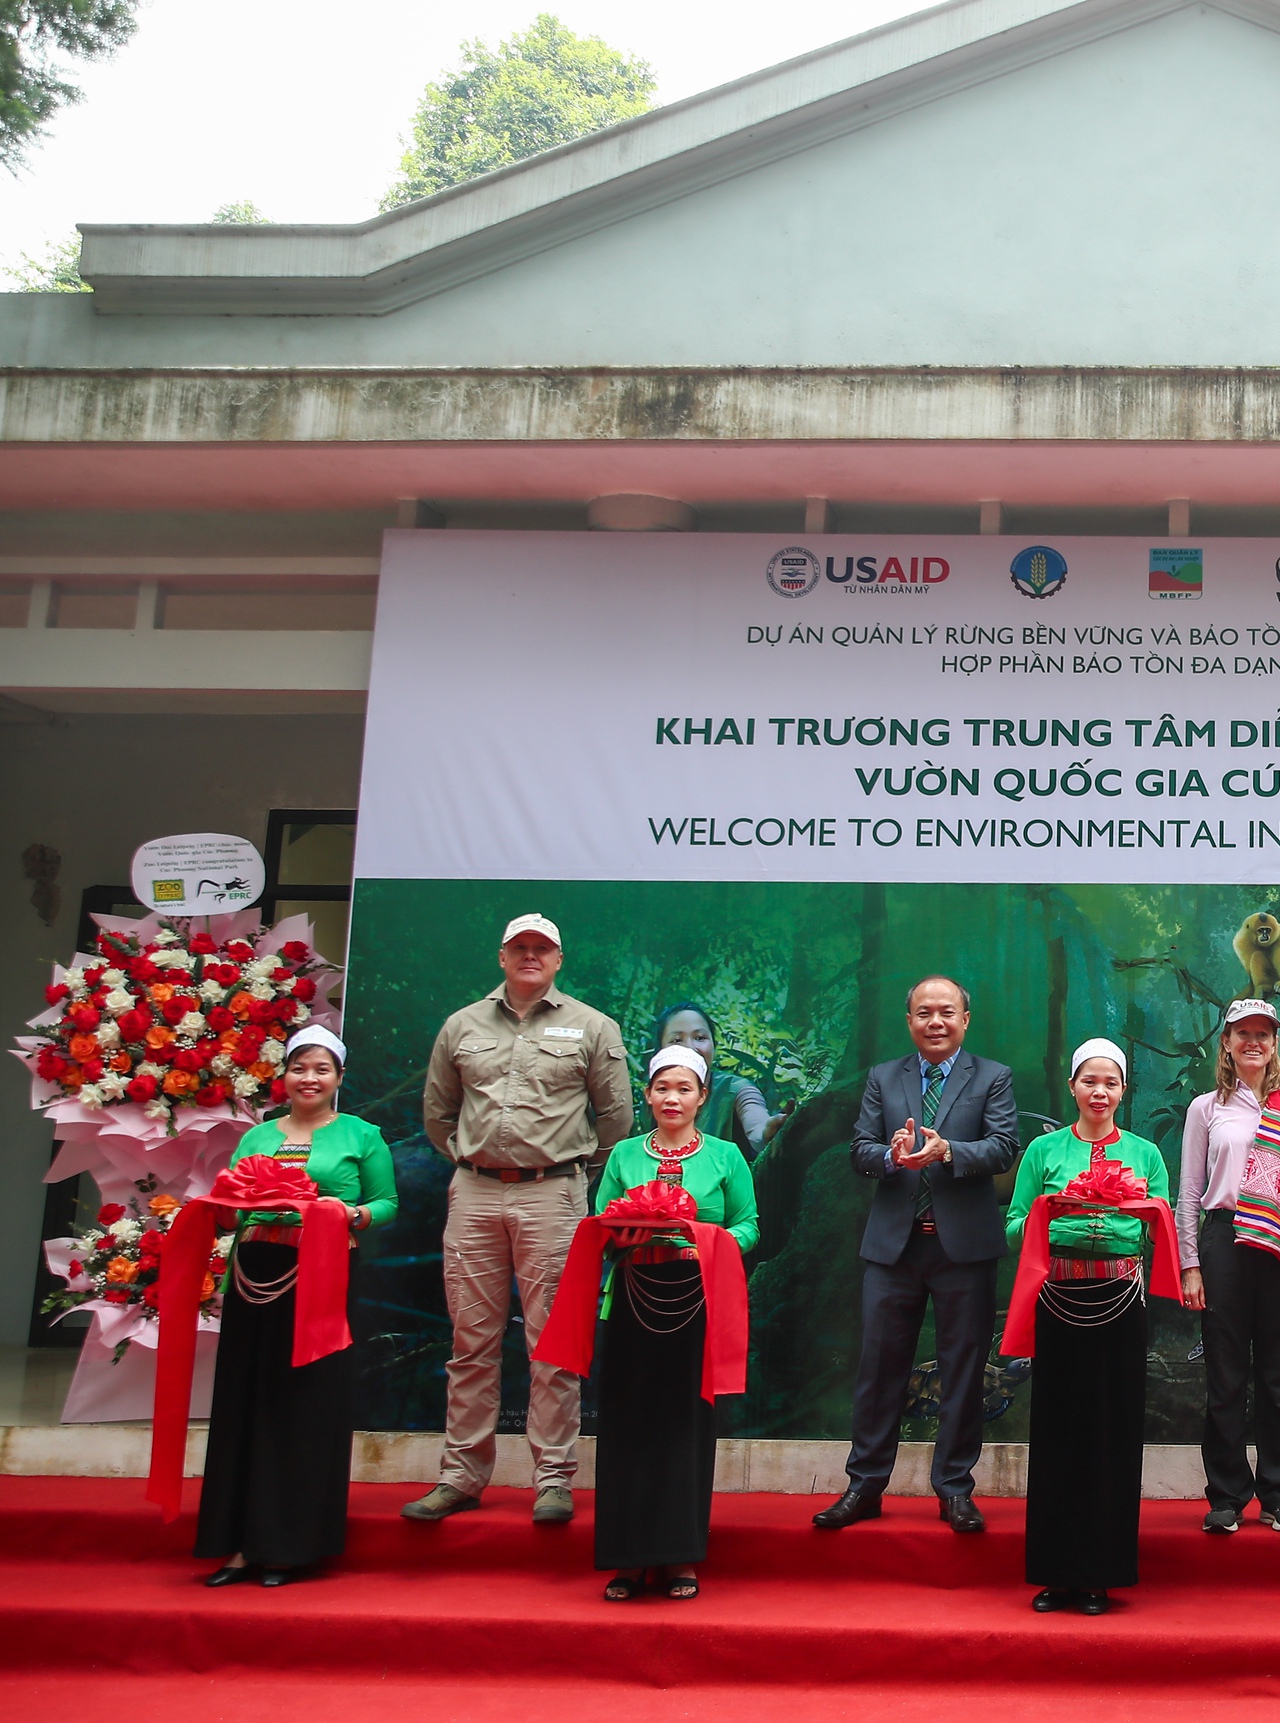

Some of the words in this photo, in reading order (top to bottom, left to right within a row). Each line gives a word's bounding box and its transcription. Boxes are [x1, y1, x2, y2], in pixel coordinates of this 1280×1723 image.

[826, 556, 950, 584] USAID
[844, 584, 857, 594] TỪ
[859, 585, 888, 594] NHÂN
[891, 585, 912, 594] DÂN
[915, 584, 930, 594] MỸ
[747, 624, 783, 647] DỰ
[788, 622, 824, 644] ÁN
[831, 622, 904, 647] QUẢN
[912, 623, 938, 645] LÝ
[945, 623, 1014, 645] RỪNG
[1022, 622, 1066, 646] BỀN
[1074, 623, 1143, 646] VỮNG
[1149, 623, 1182, 646] VÀ
[1190, 623, 1239, 646] BẢO
[942, 655, 992, 677] HỢP
[999, 651, 1064, 673] PHẦN
[1073, 651, 1122, 674] BẢO
[1130, 650, 1183, 674] TỒN
[1190, 656, 1227, 674] ĐA
[656, 718, 755, 746] KHAI
[769, 716, 950, 747] TRƯƠNG
[964, 719, 1112, 747] TRUNG
[1125, 714, 1216, 748] TÂM
[854, 760, 980, 796] VƯỜN
[993, 758, 1122, 802] QUỐC
[1135, 768, 1210, 797] GIA
[648, 817, 837, 847] WELCOME
[847, 818, 903, 847] TO
[916, 818, 1237, 848] ENVIRONMENTAL
[157, 883, 181, 891] ZOO
[229, 891, 252, 900] EPRC
